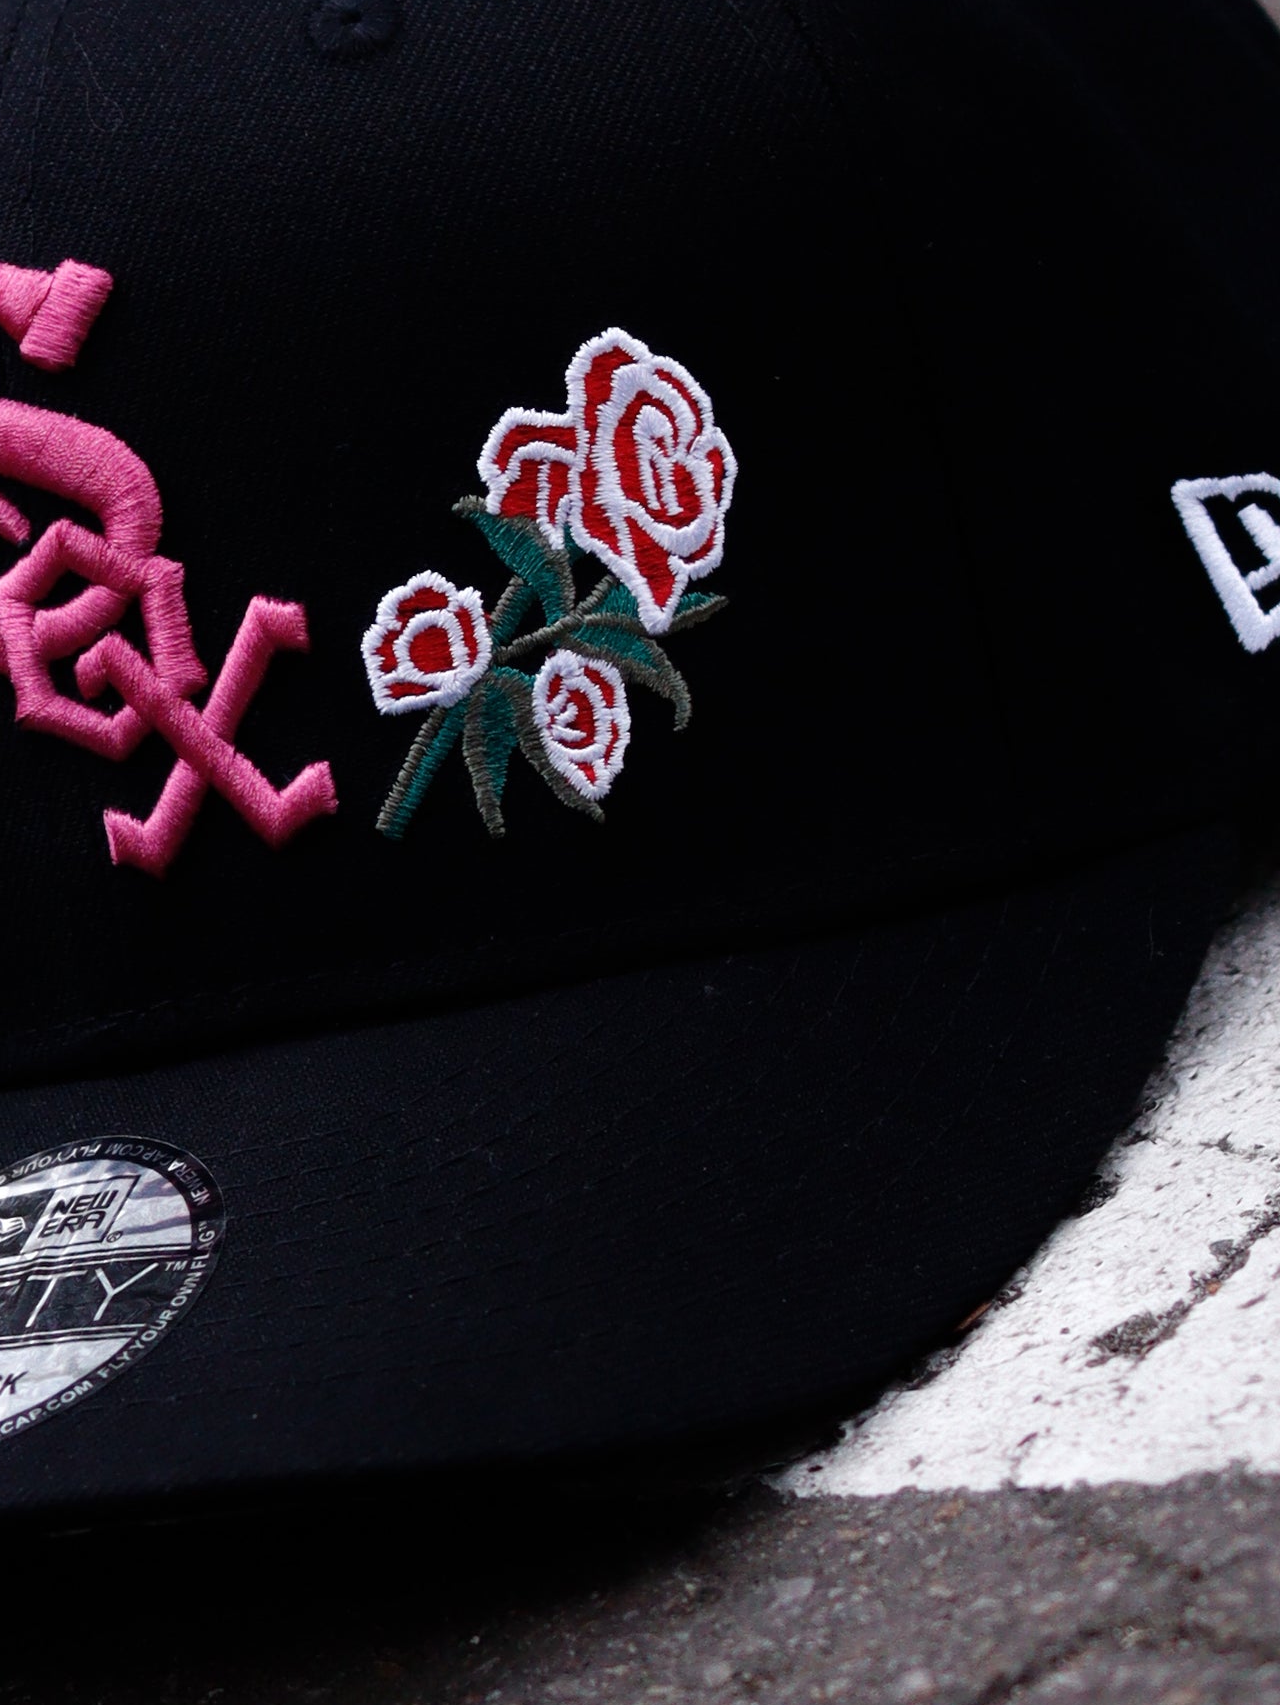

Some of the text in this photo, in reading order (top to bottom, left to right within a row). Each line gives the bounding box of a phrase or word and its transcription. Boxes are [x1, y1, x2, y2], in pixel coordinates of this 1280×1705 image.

[50, 1189, 119, 1217] NEW
[38, 1211, 107, 1239] ERA
[97, 1350, 131, 1379] FLY
[130, 1309, 178, 1349] YOUR
[171, 1271, 202, 1307] OWN
